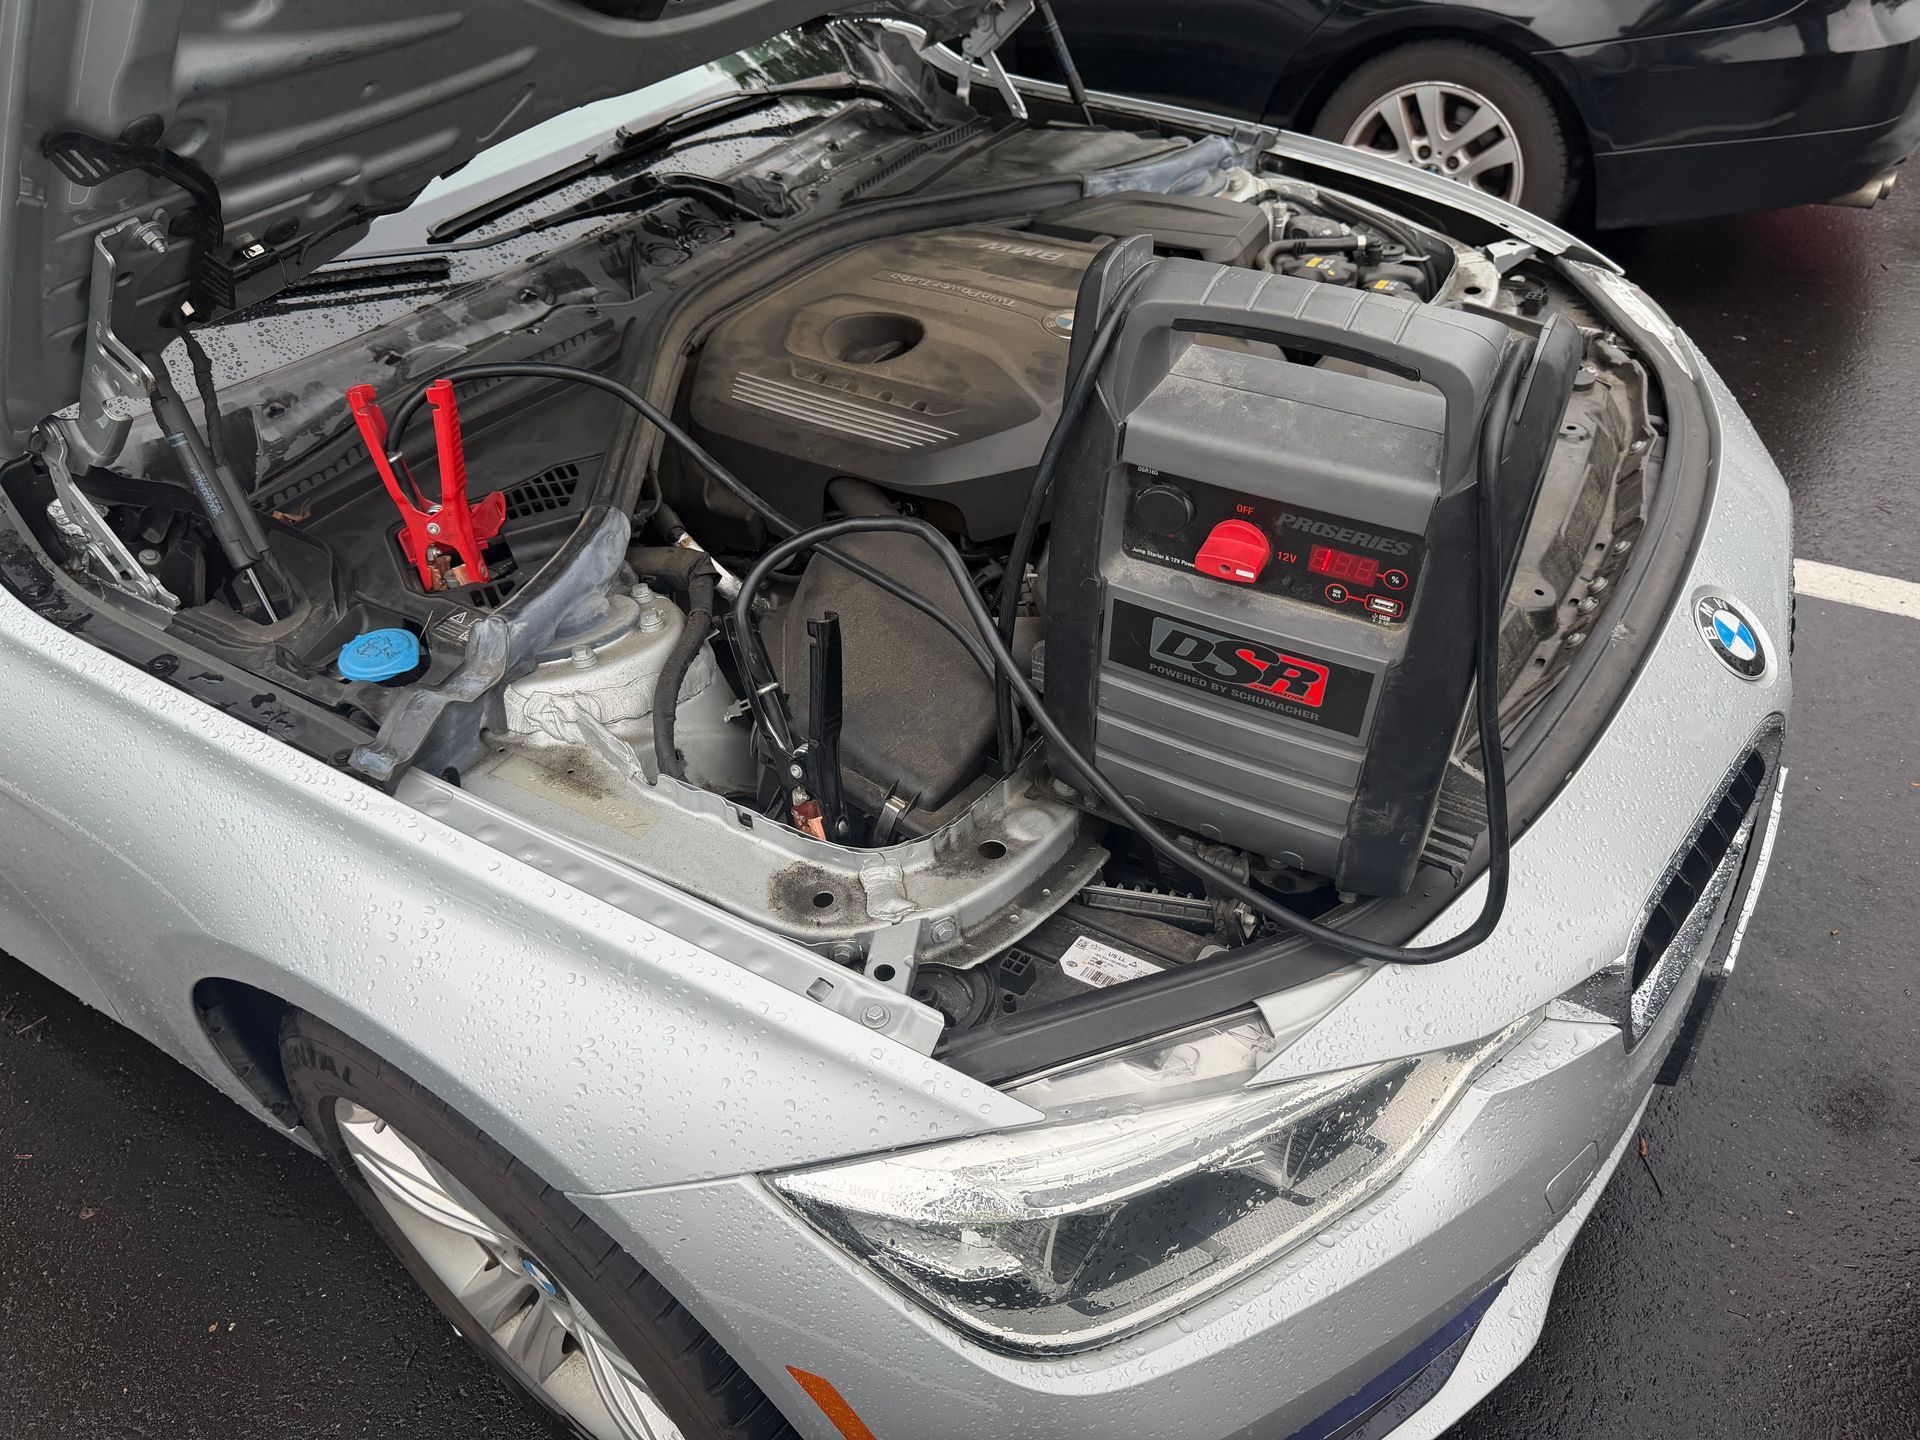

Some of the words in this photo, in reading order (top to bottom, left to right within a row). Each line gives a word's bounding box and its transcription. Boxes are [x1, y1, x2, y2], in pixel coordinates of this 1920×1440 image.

[979, 241, 1065, 262] BMW
[890, 273, 931, 288] Turbo
[933, 281, 1017, 308] TwinPower
[1236, 504, 1255, 515] OFF
[1276, 512, 1413, 556] PROSERIES
[1146, 550, 1165, 559] Starter
[1277, 551, 1297, 564] 12V
[1699, 597, 1729, 640] BMW
[1155, 629, 1322, 698] DSR
[1149, 662, 1208, 688] POWERED
[1210, 682, 1229, 694] BY
[1230, 688, 1321, 722] SCHUMACHER
[1253, 684, 1305, 702] CORPORATION
[848, 1183, 879, 1201] BMW
